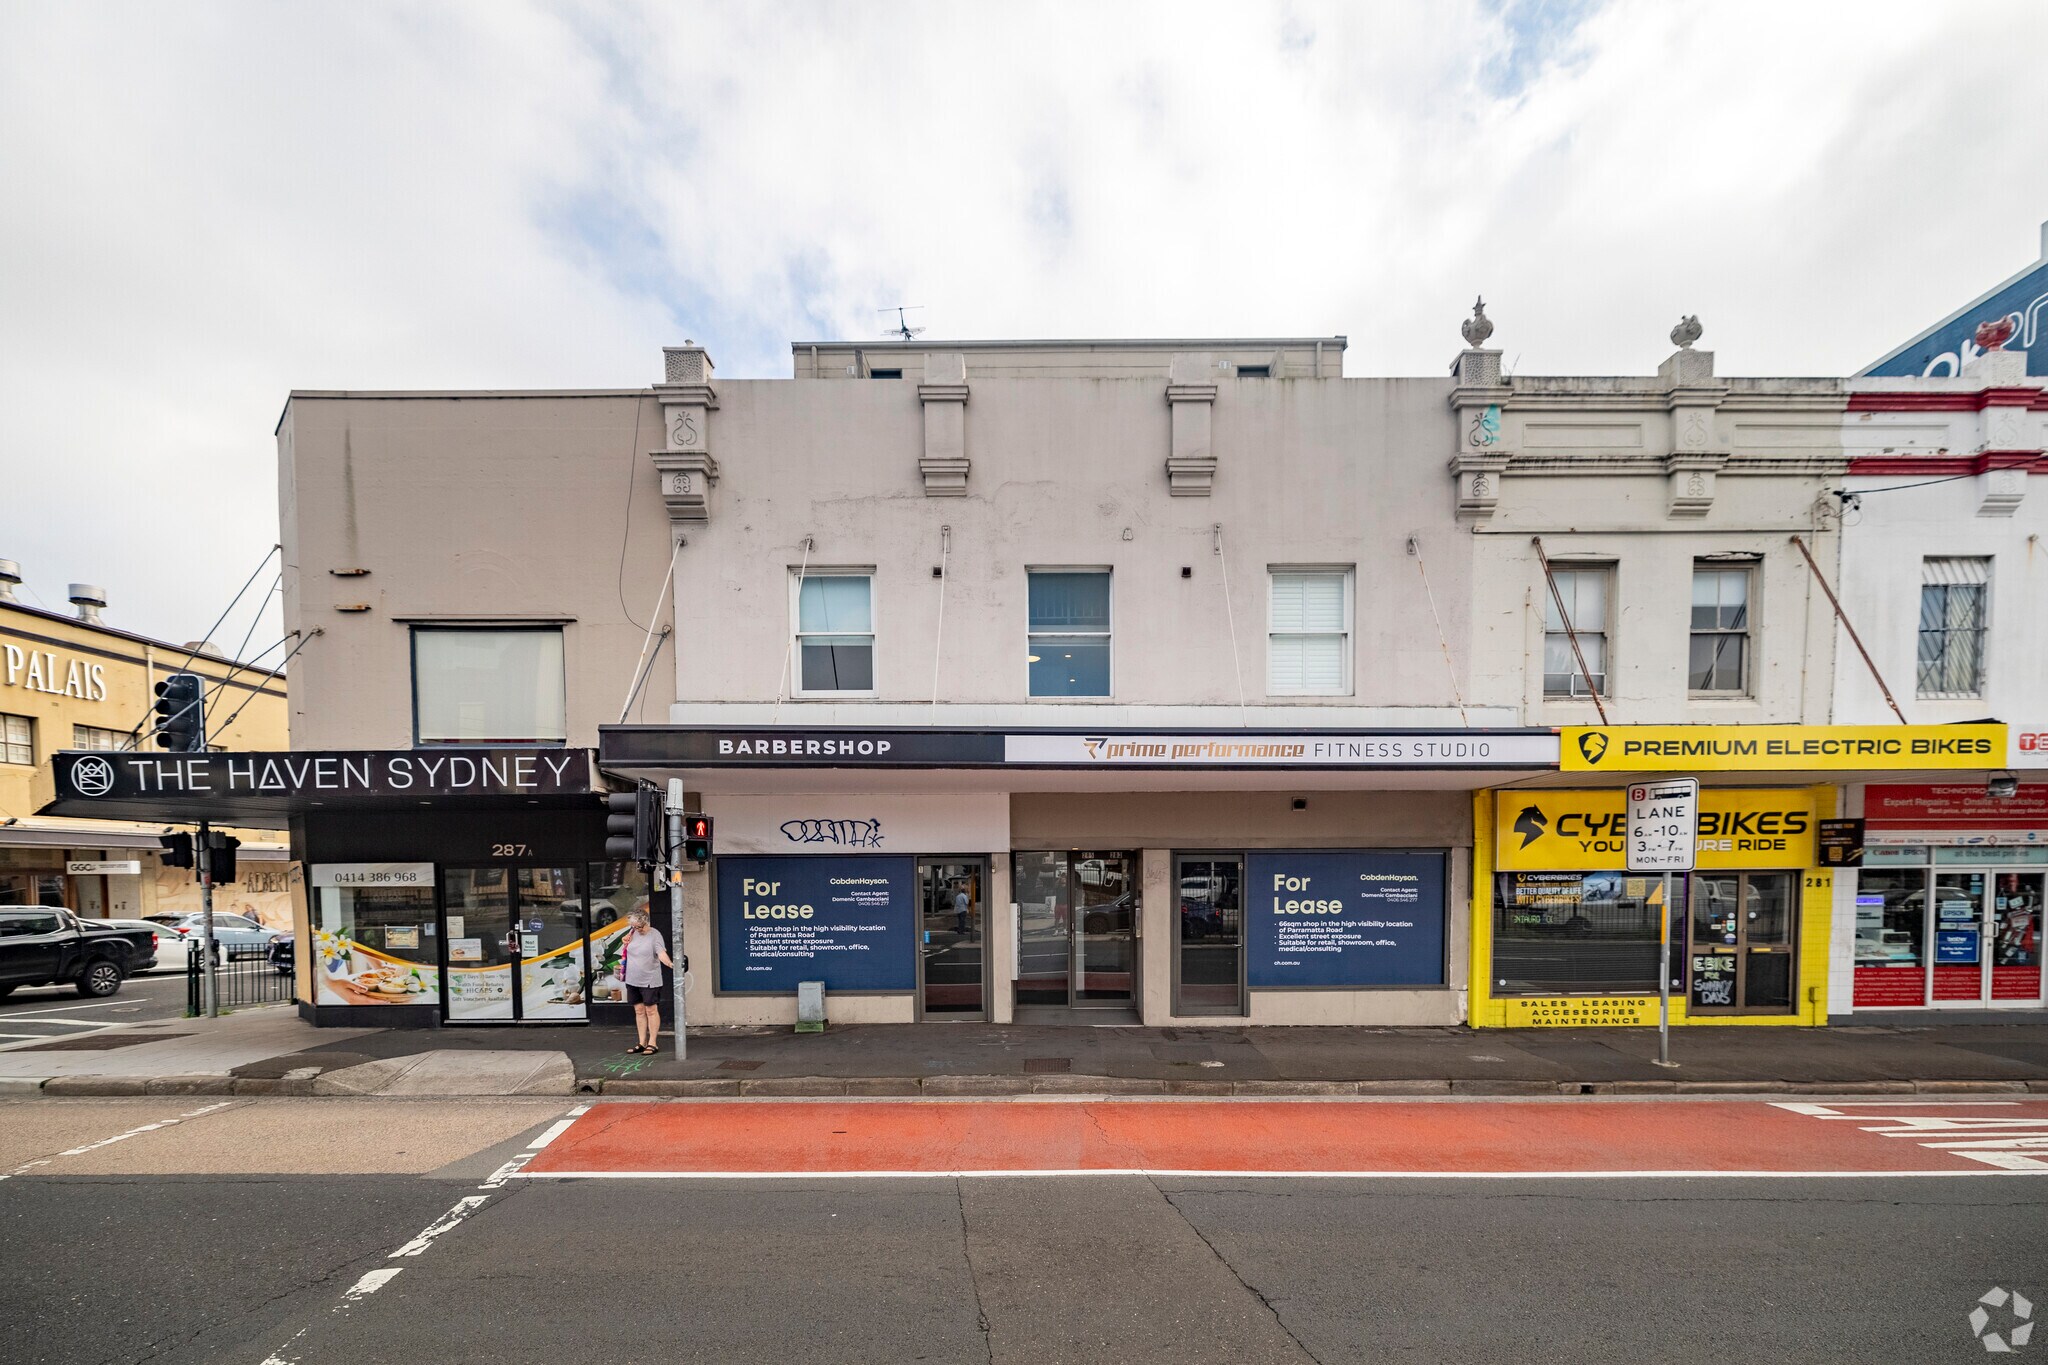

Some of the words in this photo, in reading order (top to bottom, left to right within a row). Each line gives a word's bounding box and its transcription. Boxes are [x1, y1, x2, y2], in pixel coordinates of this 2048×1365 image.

[4, 643, 107, 702] PALAIS
[719, 739, 891, 755] BARBERSHOP
[1106, 742, 1166, 759] prime
[1171, 742, 1305, 759] performance
[1314, 743, 1403, 757] FITNESS
[1413, 743, 1490, 757] STUDIO
[1624, 740, 1757, 756] PREMIUM
[1766, 739, 1901, 755] ELECTRIC
[1911, 738, 1992, 754] BIKES
[128, 759, 211, 791] THE
[228, 757, 370, 791] HAVEN
[388, 756, 571, 789] SYDNEY
[1637, 806, 1685, 819] LANE
[1579, 841, 1624, 852] YOU
[1738, 839, 1786, 851] RIDE
[335, 871, 364, 883] 0414
[368, 871, 391, 883] 386
[394, 871, 417, 883] 968
[1274, 874, 1311, 892] For
[1806, 877, 1831, 888] 281
[743, 879, 781, 896] For
[1516, 887, 1537, 895] BETTER
[1538, 887, 1561, 895] QUALITY
[1570, 887, 1582, 895] LIFE
[1274, 896, 1343, 914] Lease
[1516, 895, 1534, 905] WITH
[743, 901, 814, 919] Lease
[749, 925, 773, 933] 40sqm
[775, 925, 791, 933] shop
[813, 925, 828, 933] high
[830, 925, 858, 933] visibility
[1704, 971, 1720, 980] FOR
[1694, 979, 1733, 995] SUNNY
[1701, 991, 1731, 1004] DAYS
